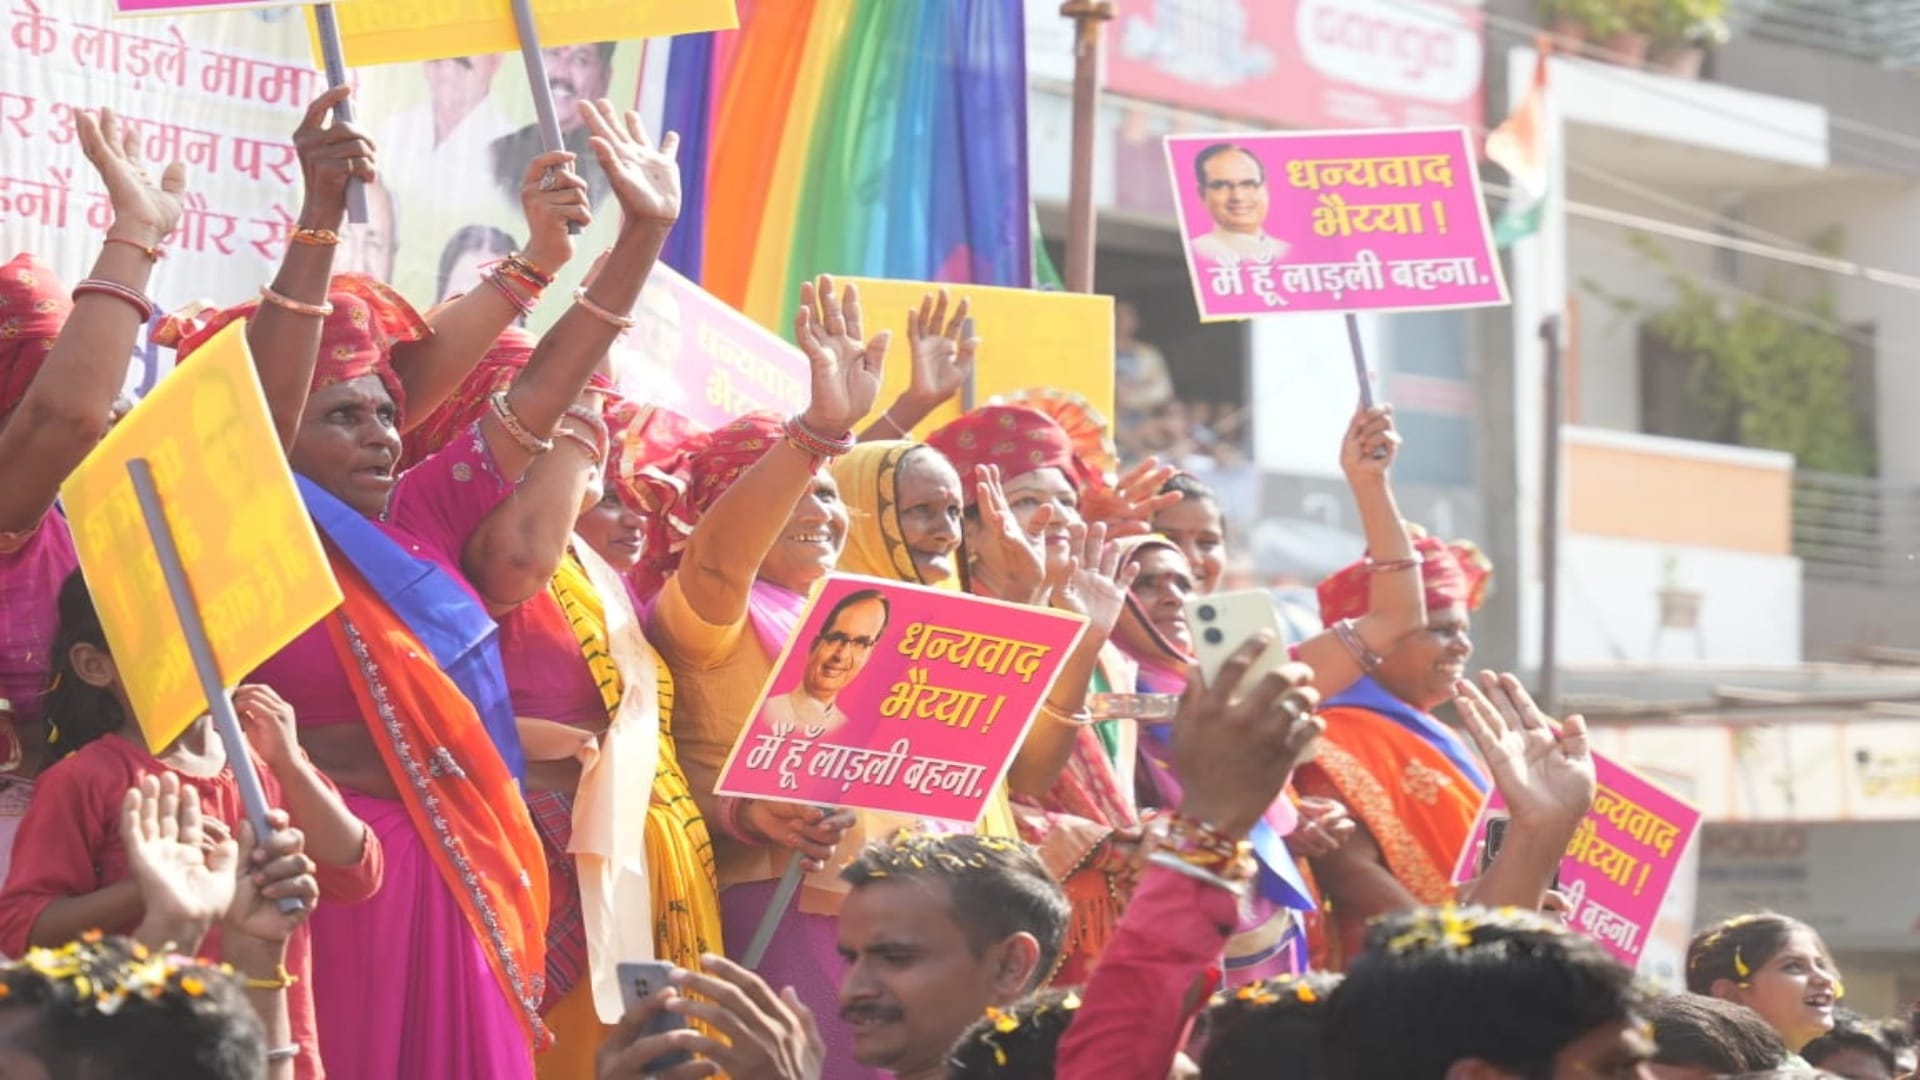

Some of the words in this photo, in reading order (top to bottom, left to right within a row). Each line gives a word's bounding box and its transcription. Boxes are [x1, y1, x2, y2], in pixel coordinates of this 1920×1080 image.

[11, 0, 58, 56] के
[71, 24, 191, 91] लाड़ले
[0, 91, 36, 139] र
[232, 137, 298, 185] पर
[1285, 154, 1454, 190] धन्यवाद
[1312, 193, 1424, 237] भैय्या
[1433, 200, 1448, 235] !
[1208, 251, 1244, 297] मैं
[1249, 252, 1288, 307] हूँ
[1277, 248, 1385, 301] लाड़ली
[1388, 256, 1490, 291] बहना.
[897, 621, 1051, 683] धन्यवाद
[879, 667, 986, 730] भैय्या
[980, 694, 1006, 733] !
[746, 719, 794, 771] मैं
[778, 724, 825, 790] हूँ
[808, 737, 909, 793] लाड़ली
[903, 755, 986, 799] बहना.
[1593, 783, 1681, 857] न्यवाद
[1581, 900, 1640, 954] बहना.
